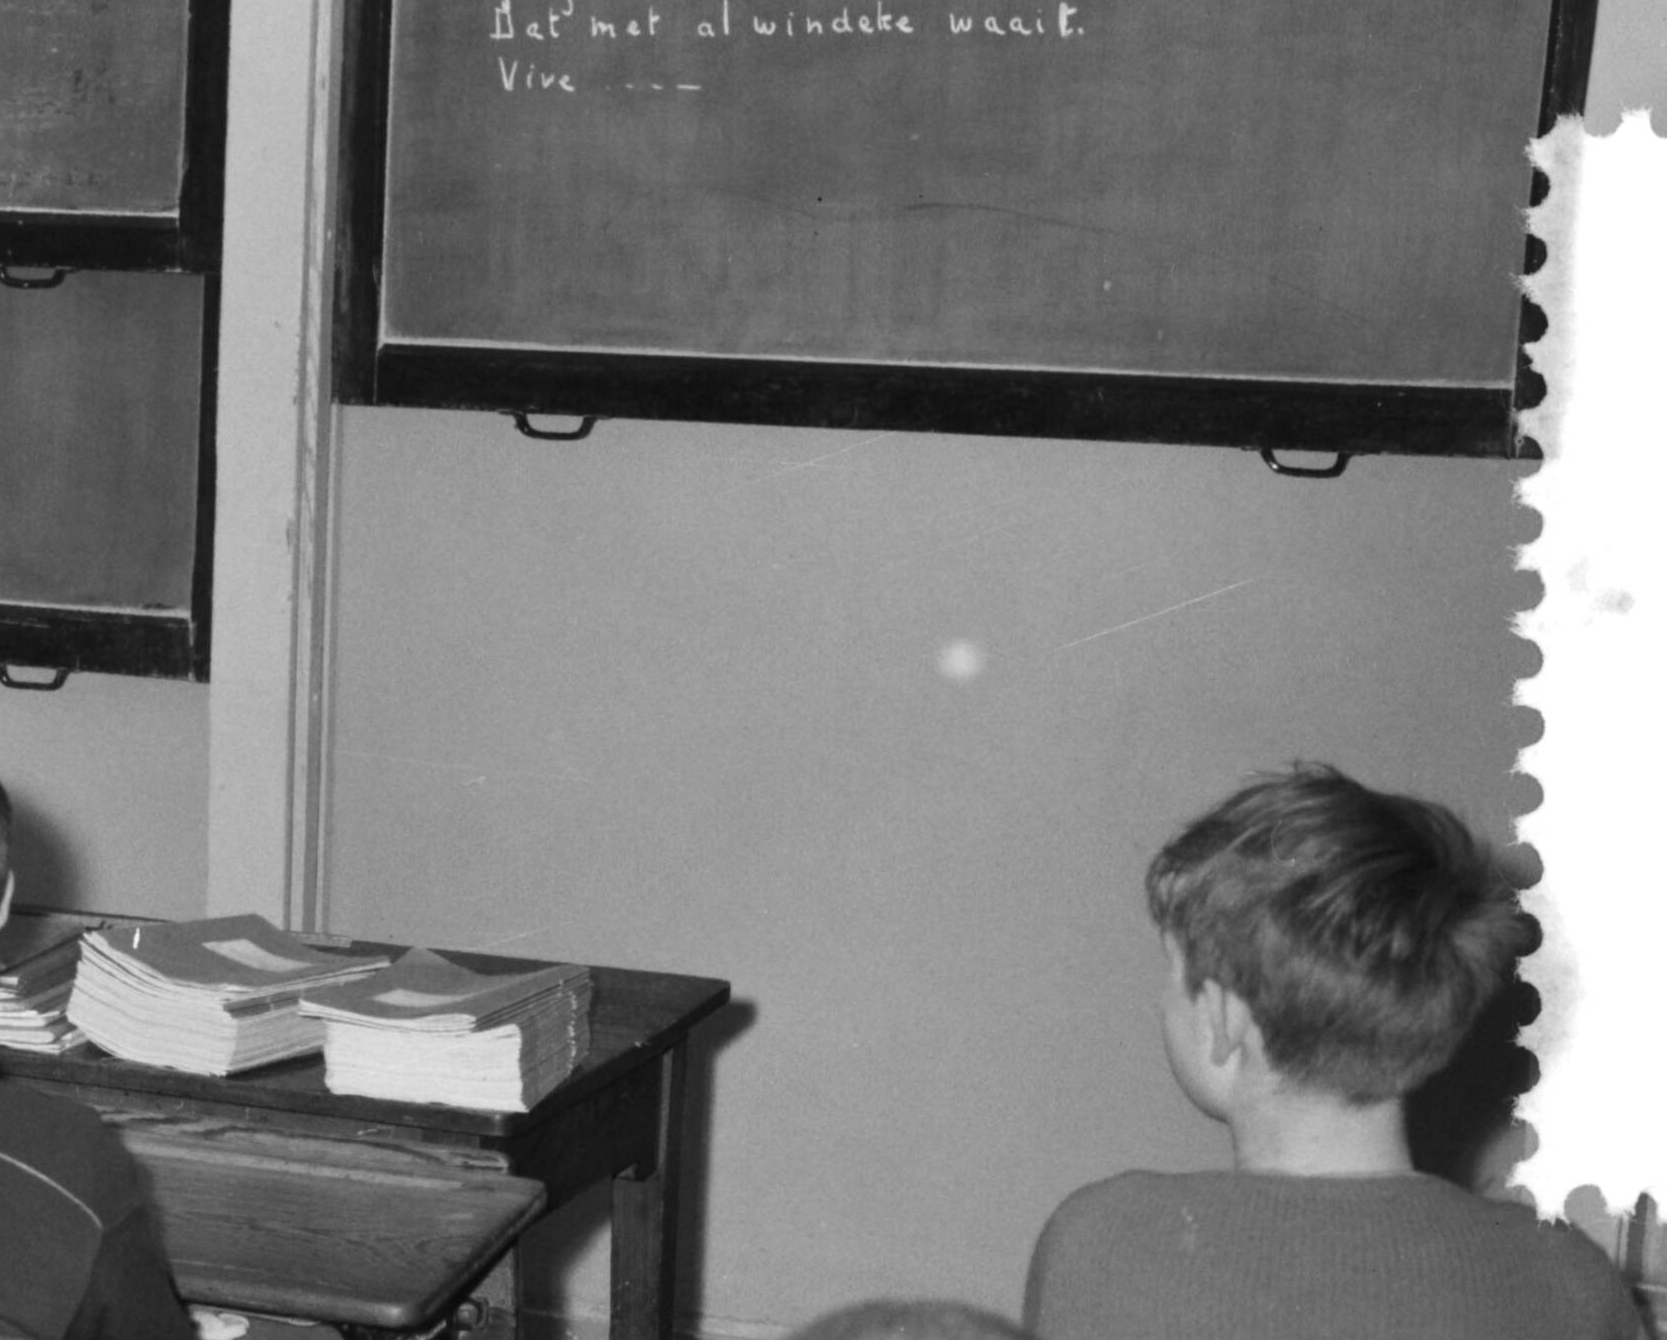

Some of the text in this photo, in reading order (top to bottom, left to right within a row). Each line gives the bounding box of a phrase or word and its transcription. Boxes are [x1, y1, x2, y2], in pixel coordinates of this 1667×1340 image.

[489, 4, 559, 40] Dat
[590, 5, 660, 39] met
[753, 0, 915, 37] windeke
[498, 56, 576, 92] Vive
